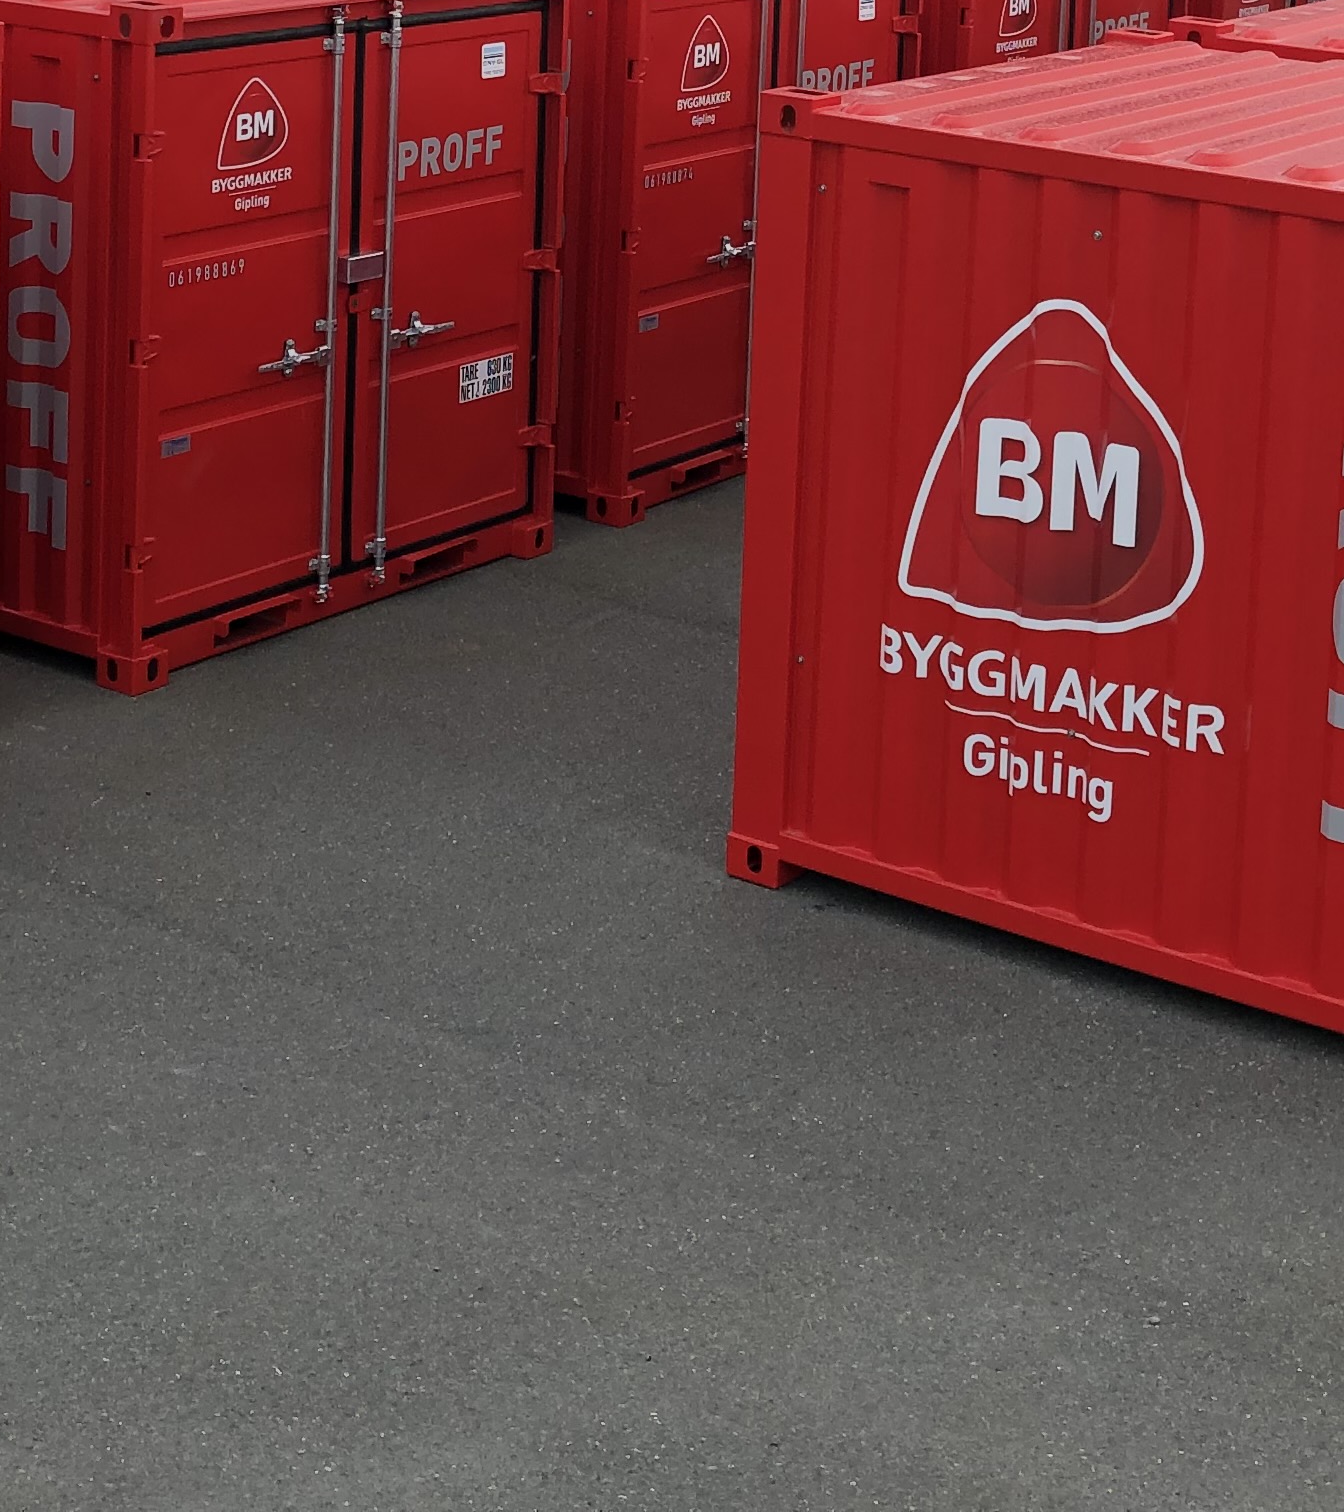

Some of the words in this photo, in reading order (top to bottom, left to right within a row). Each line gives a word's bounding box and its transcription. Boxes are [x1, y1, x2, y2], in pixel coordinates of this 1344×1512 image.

[693, 42, 721, 69] BM
[676, 90, 731, 112] BYGGMAKKER
[236, 109, 275, 142] BM
[397, 124, 504, 182] PROFF
[211, 166, 293, 194] BYGGMAKKER
[234, 194, 270, 212] Gipling
[6, 100, 75, 551] PROFF
[460, 362, 479, 384] TARE
[460, 382, 476, 402] NET
[974, 418, 1140, 548] BM
[879, 623, 1226, 755] BYGGMAKKER
[963, 732, 1114, 824] Gipling
